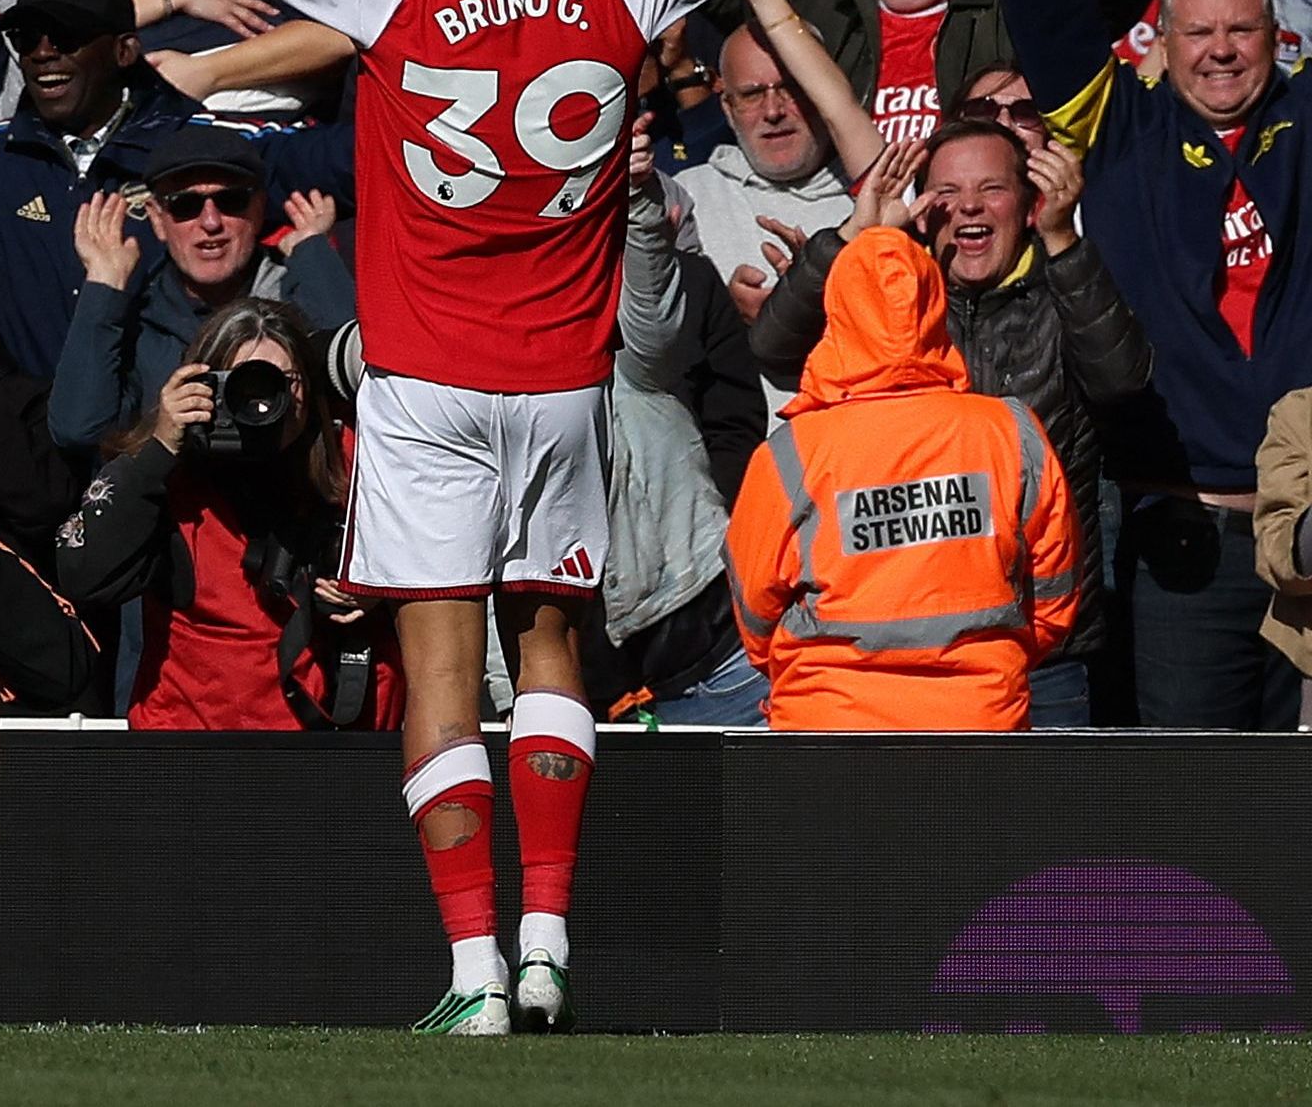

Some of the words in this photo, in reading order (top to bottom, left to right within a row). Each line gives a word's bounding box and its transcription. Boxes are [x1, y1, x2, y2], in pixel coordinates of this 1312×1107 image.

[401, 59, 627, 217] 39
[854, 476, 976, 518] ARSENAL
[852, 508, 982, 551] STEWARD
